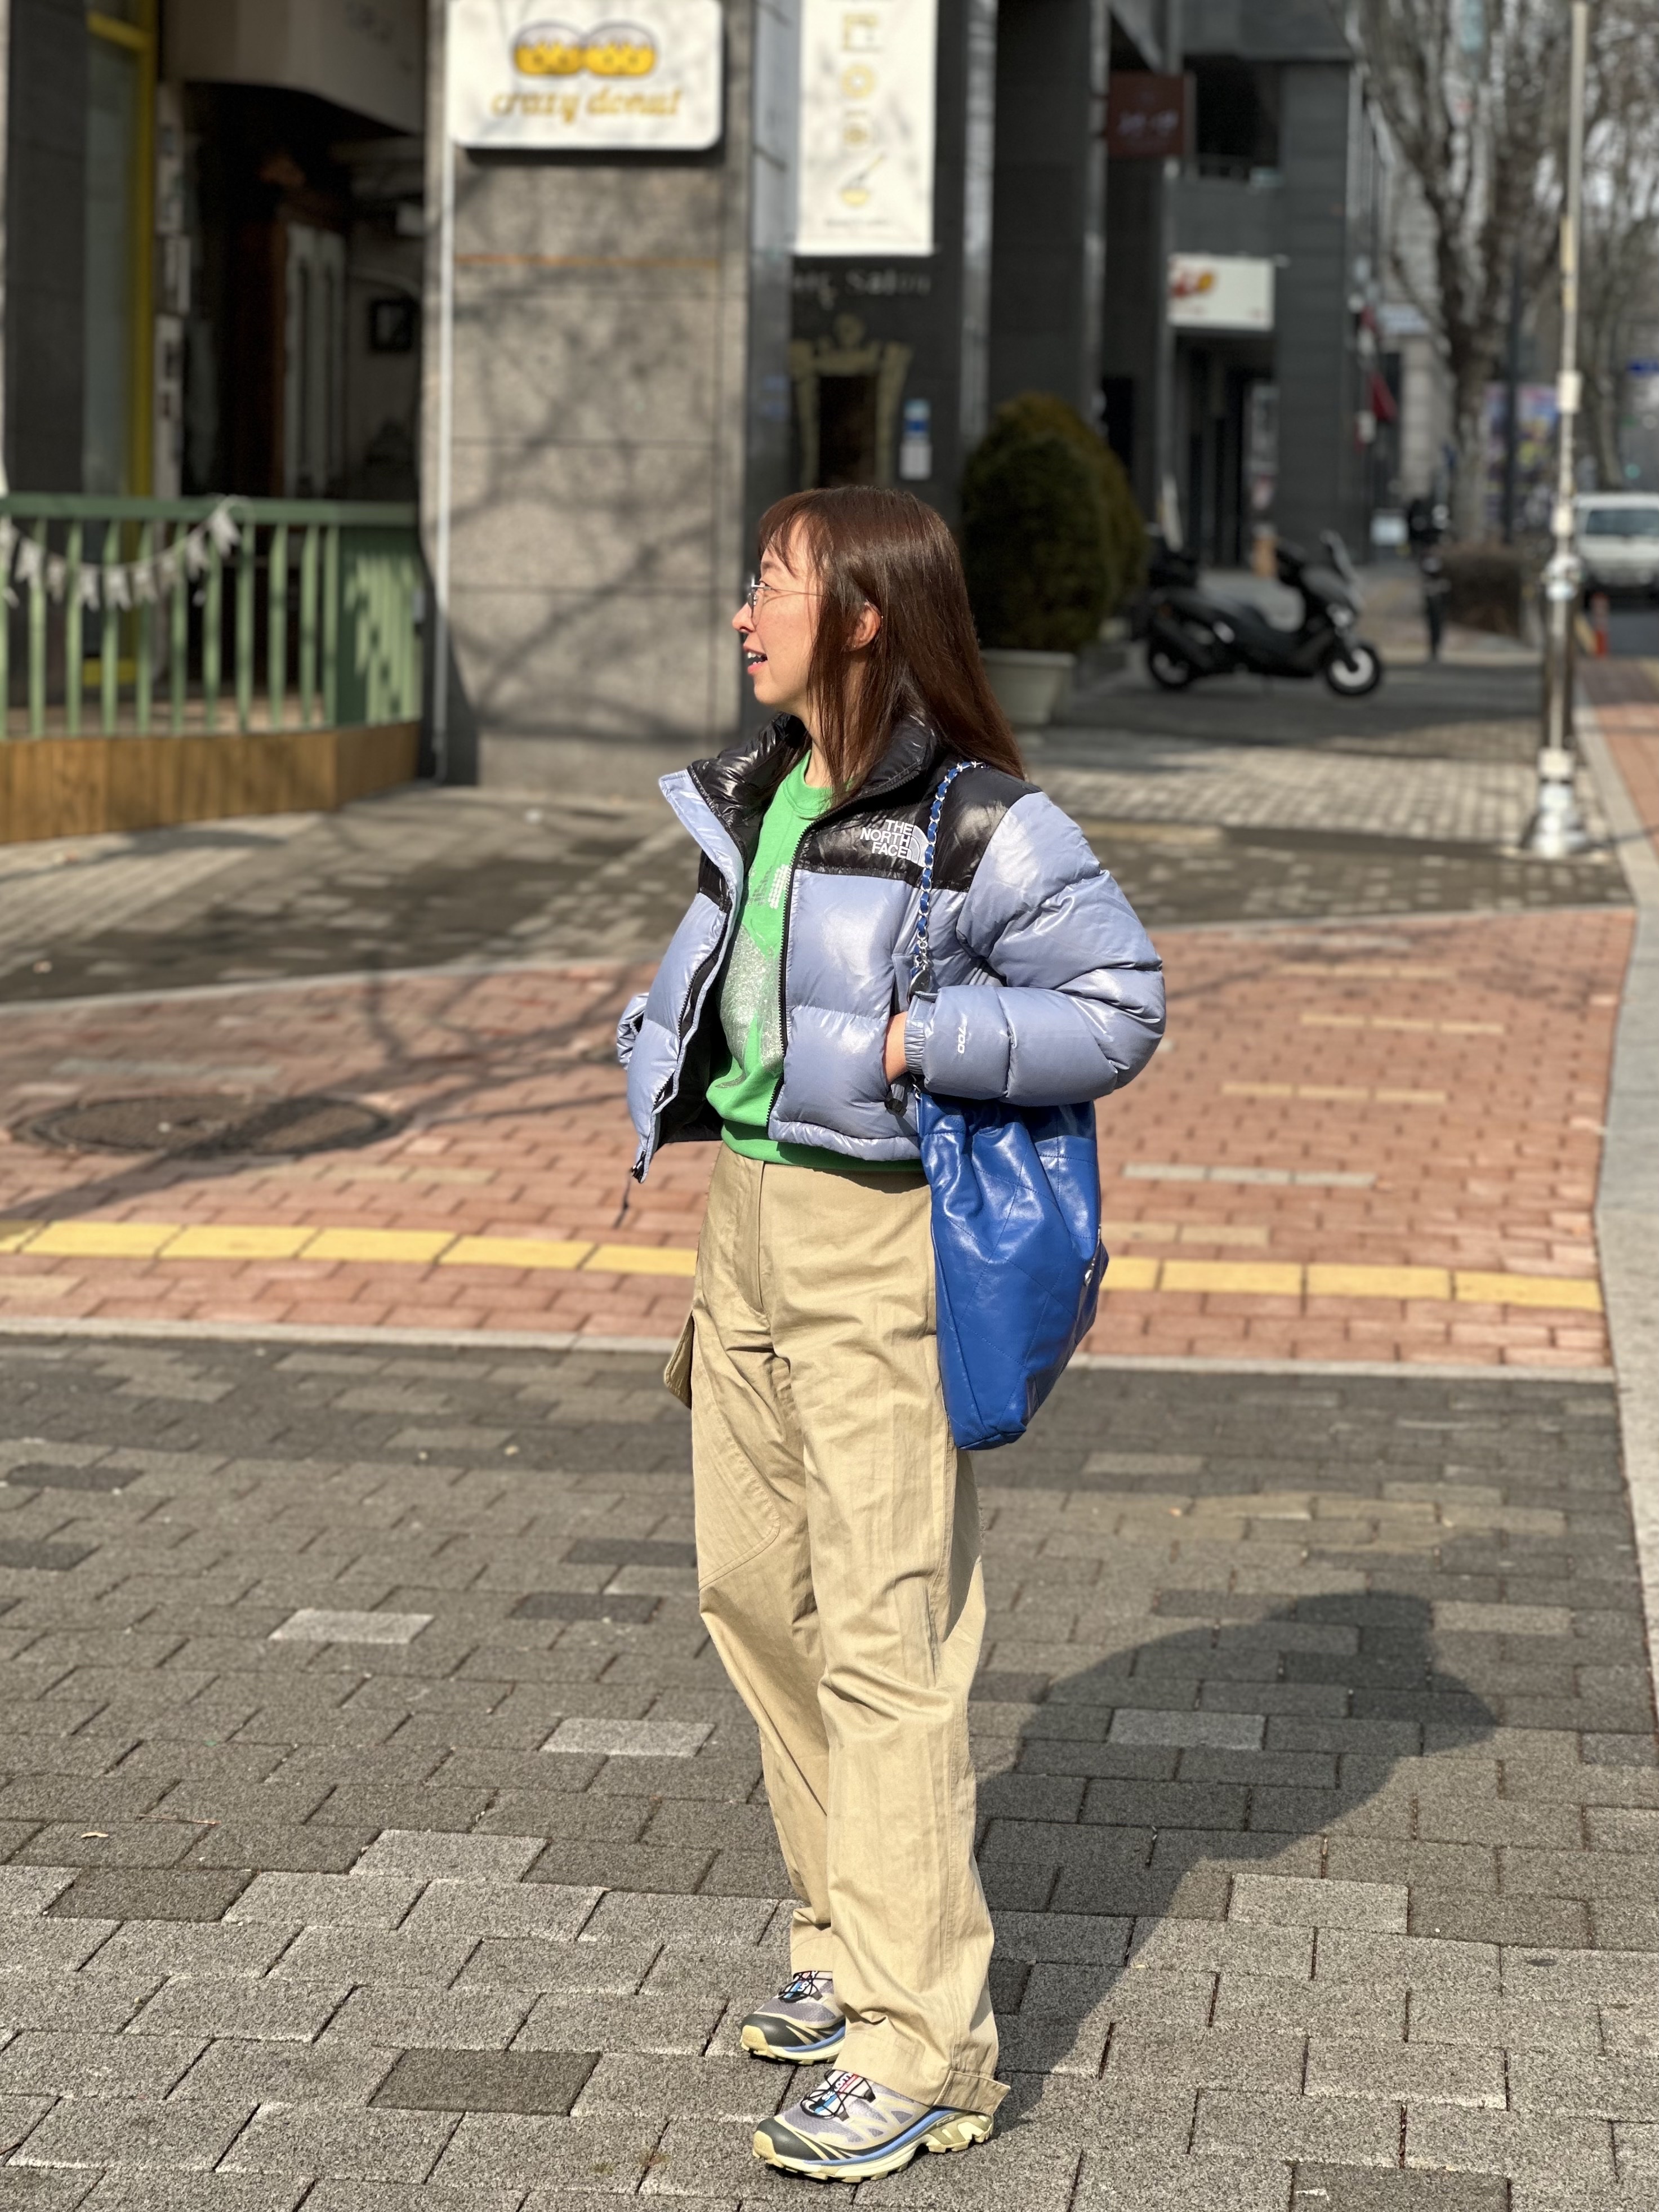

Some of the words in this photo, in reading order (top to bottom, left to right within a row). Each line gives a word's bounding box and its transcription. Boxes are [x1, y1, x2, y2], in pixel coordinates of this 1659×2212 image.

[490, 88, 579, 124] crazy
[587, 84, 682, 117] donut
[885, 819, 914, 836] THE
[860, 827, 912, 848] NORTH
[872, 841, 908, 859] FACE
